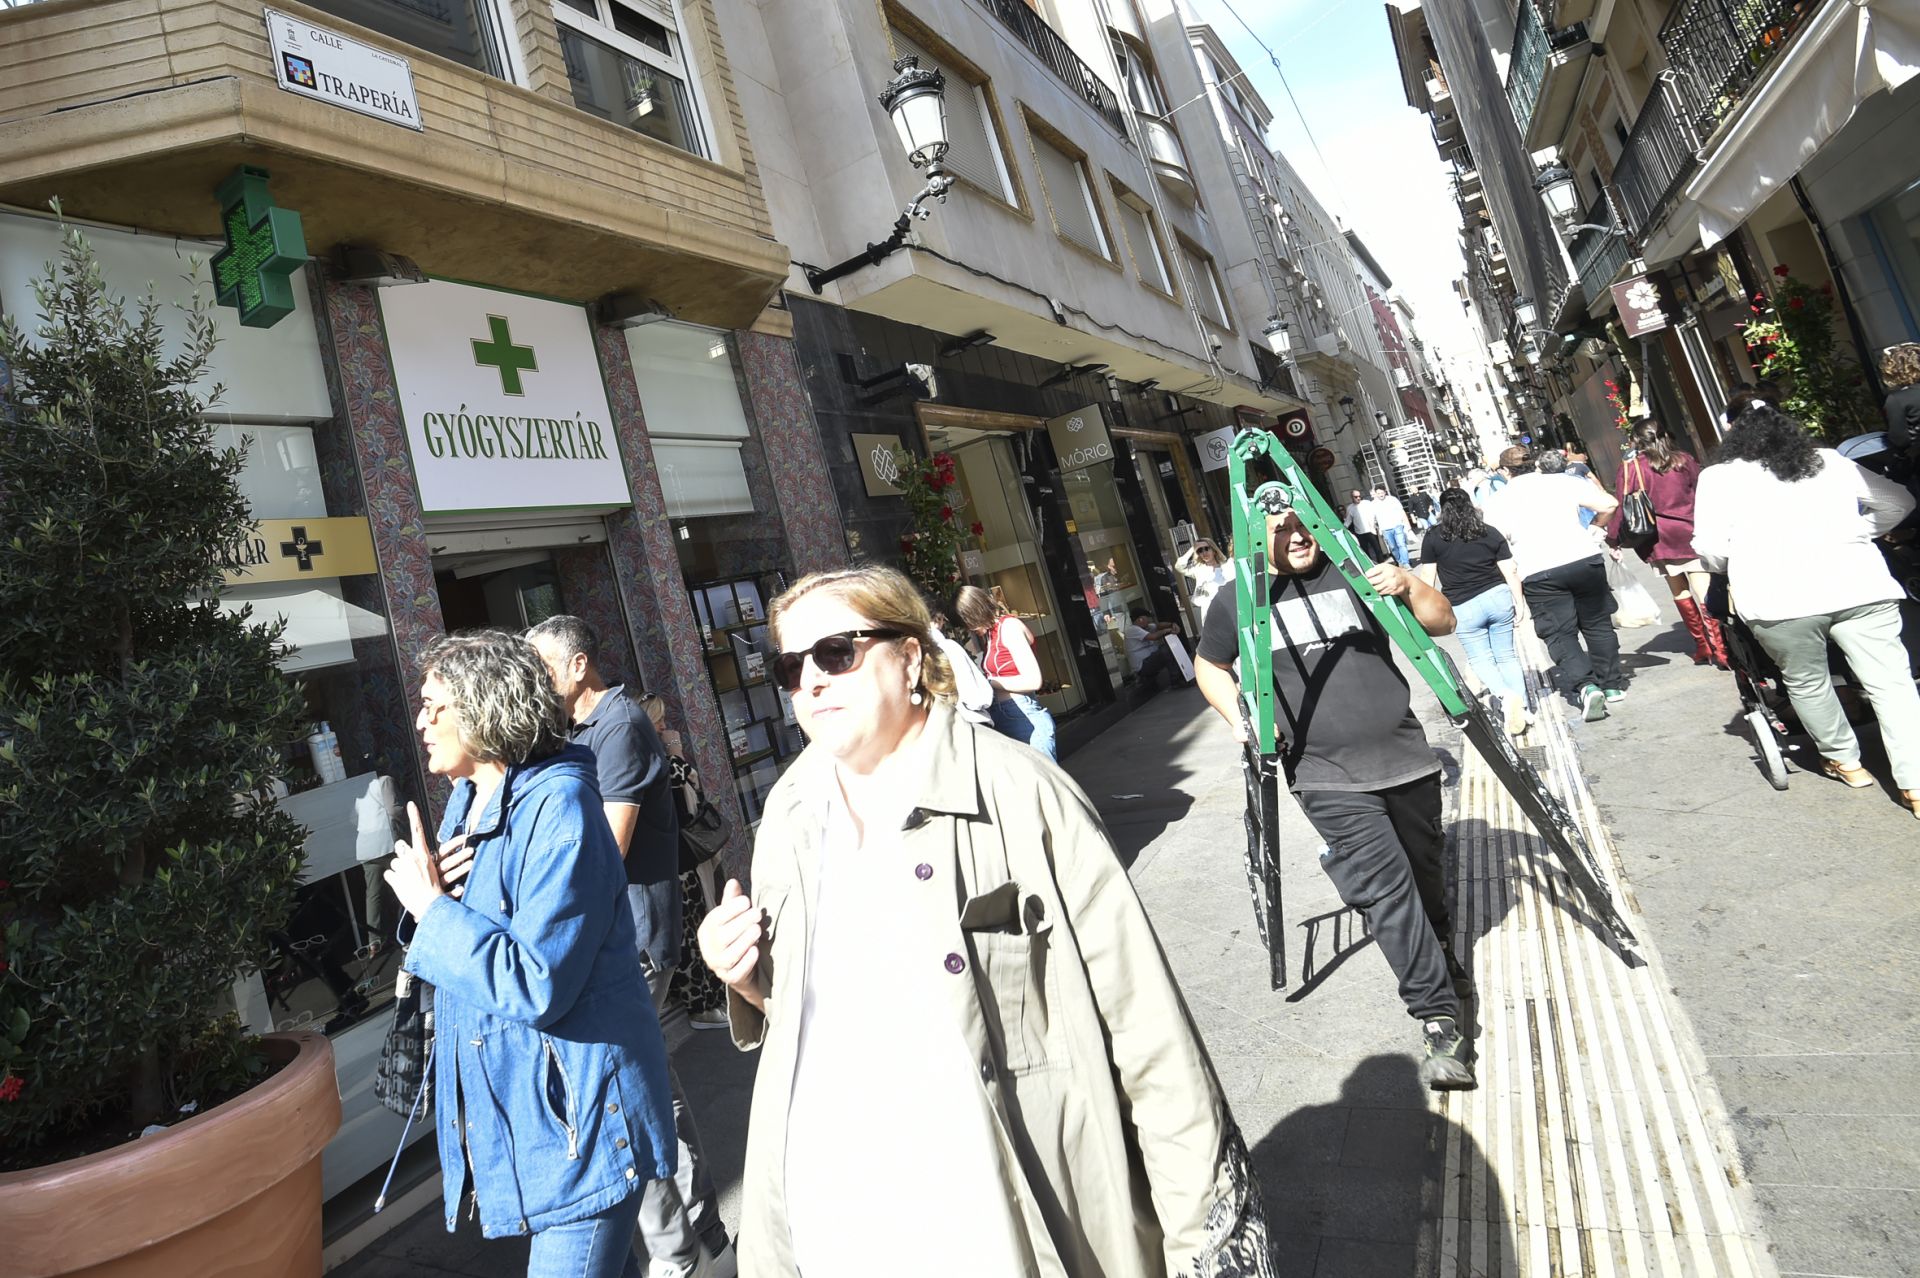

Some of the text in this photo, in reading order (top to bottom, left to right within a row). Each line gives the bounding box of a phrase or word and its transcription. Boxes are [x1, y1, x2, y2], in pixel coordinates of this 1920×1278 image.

[310, 30, 343, 50] CALLE
[318, 72, 413, 119] TRAPERÍA
[423, 403, 609, 460] GYÓGYSZERTÁR
